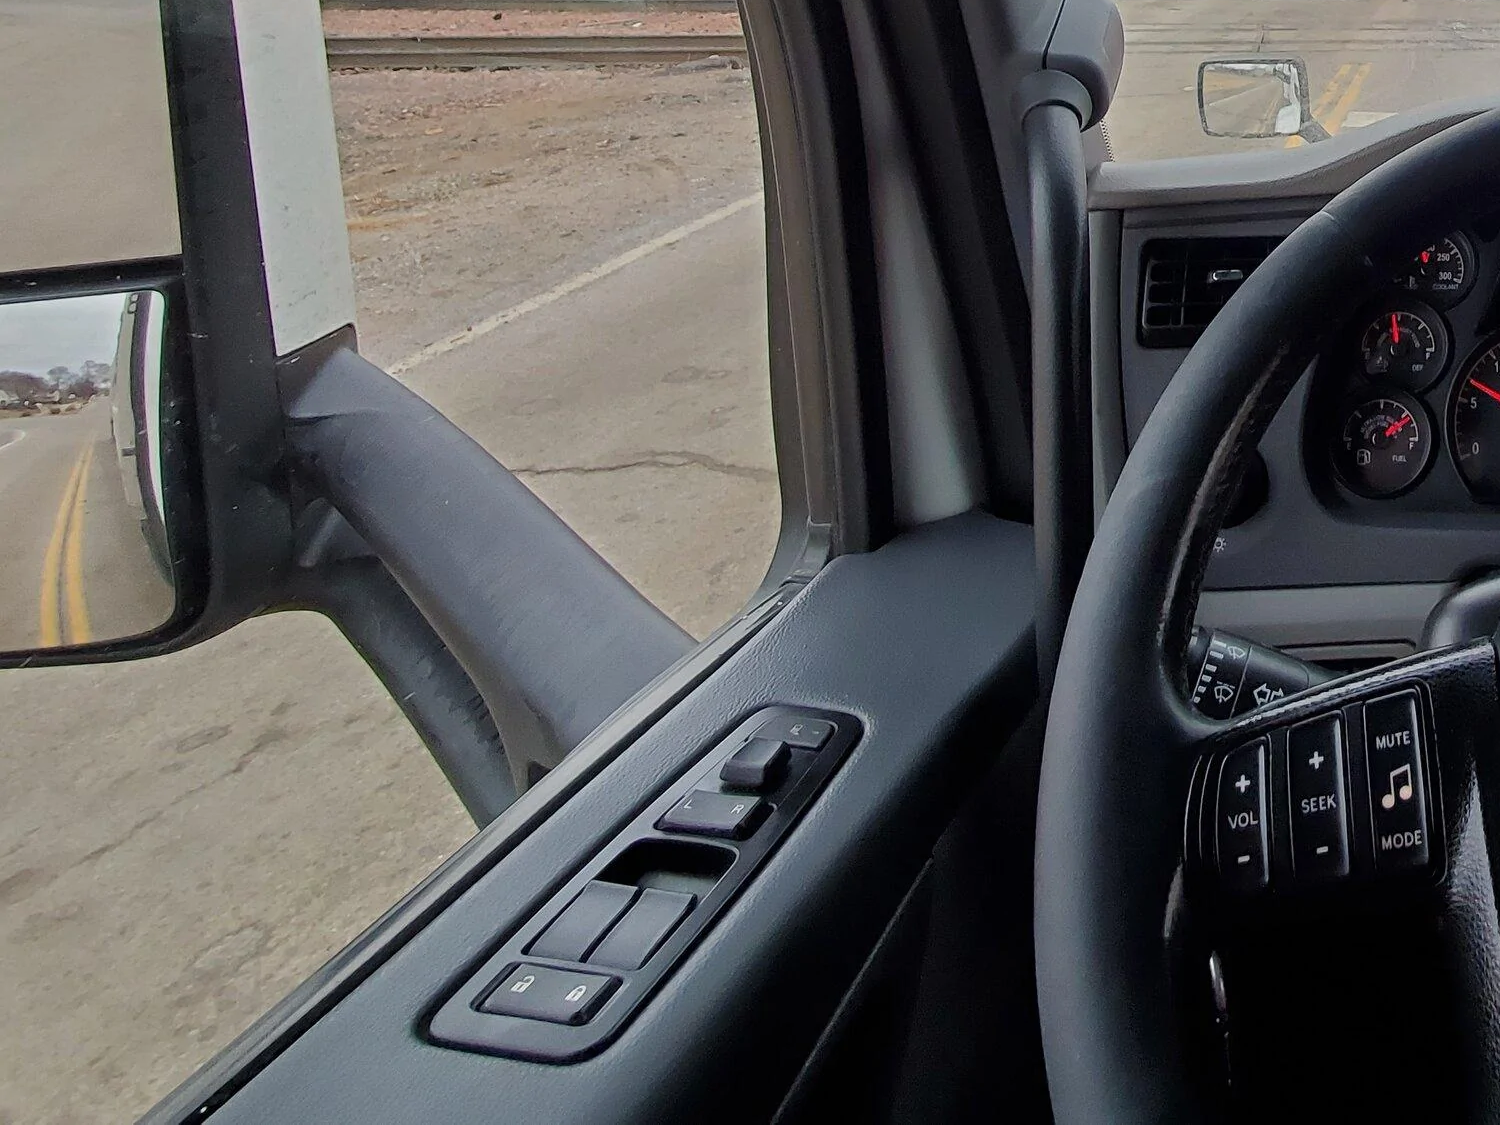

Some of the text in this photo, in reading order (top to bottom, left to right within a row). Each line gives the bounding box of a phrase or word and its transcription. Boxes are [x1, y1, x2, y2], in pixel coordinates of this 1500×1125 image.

[1437, 253, 1451, 262] 250
[1438, 271, 1452, 281] 300
[1470, 397, 1477, 409] 5
[1409, 442, 1414, 451] F
[1472, 443, 1480, 455] 0
[1392, 454, 1407, 463] FUEL
[1375, 731, 1411, 750] MUTE
[684, 799, 692, 809] L
[731, 804, 744, 815] R
[1301, 794, 1337, 814] SEEK
[1228, 811, 1259, 830] VOL
[1381, 829, 1422, 850] MODE
